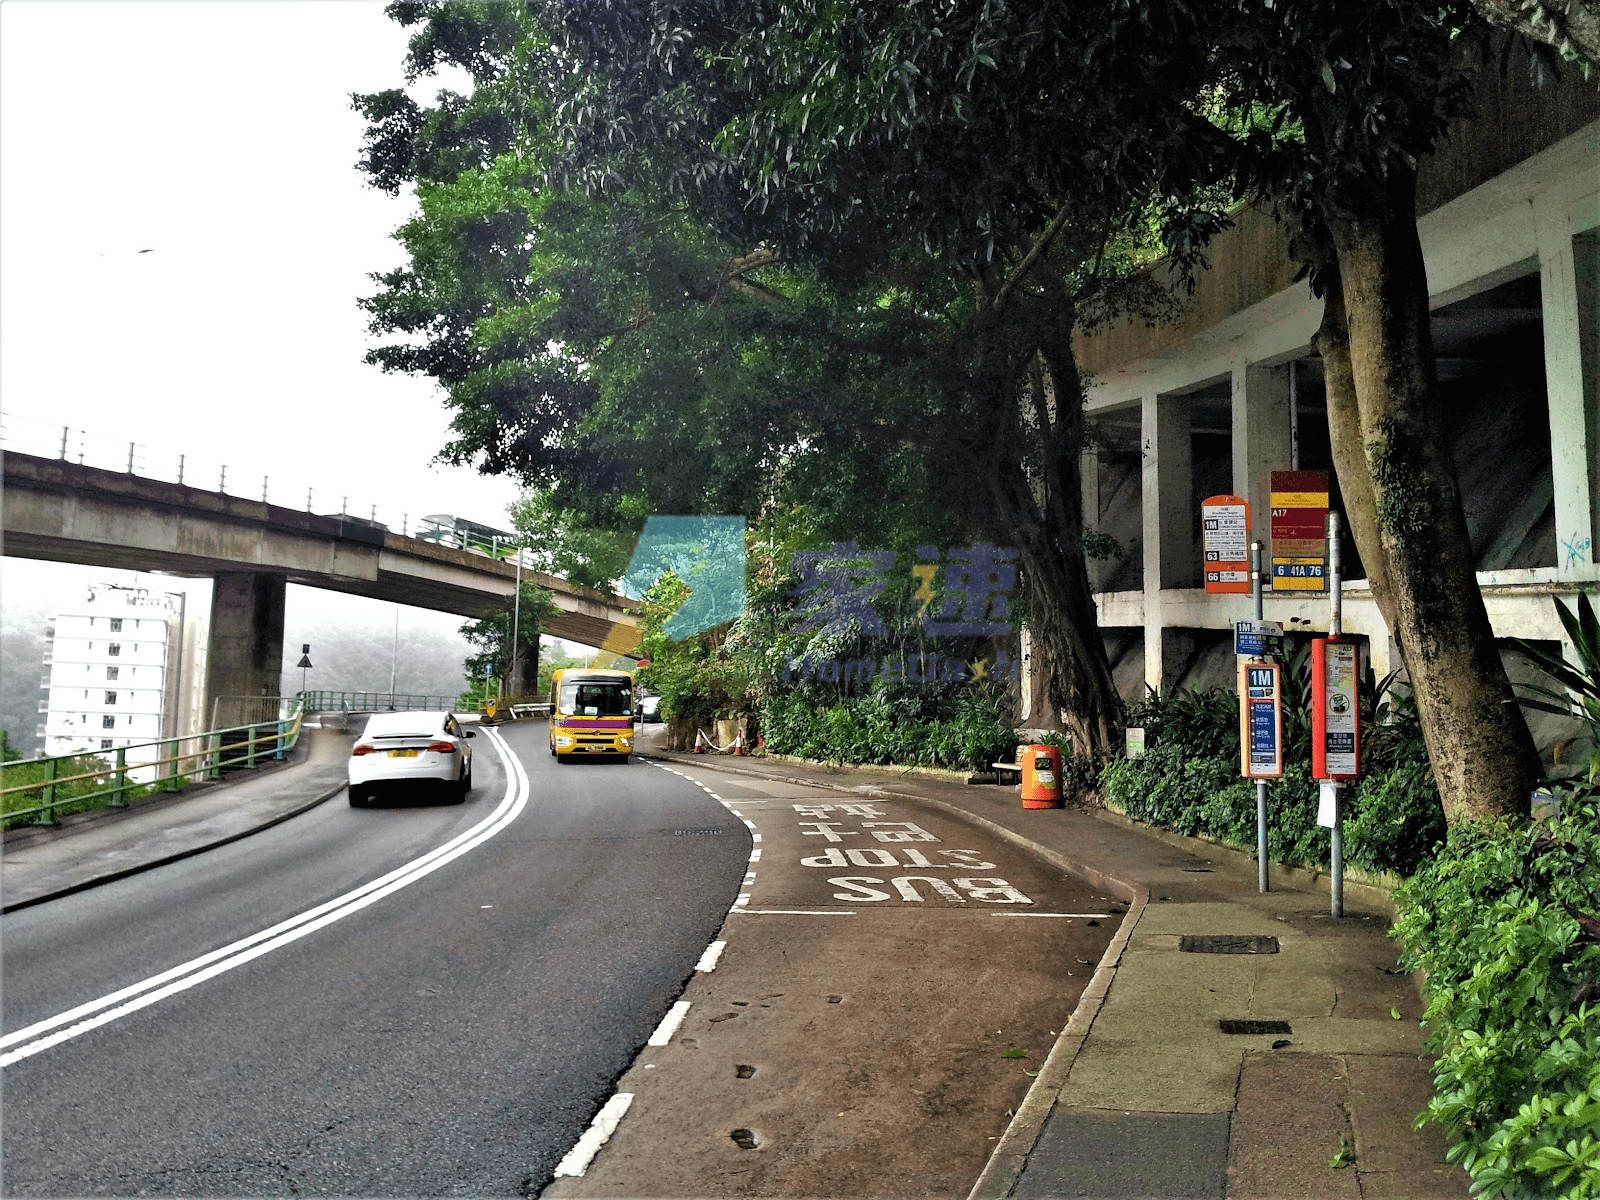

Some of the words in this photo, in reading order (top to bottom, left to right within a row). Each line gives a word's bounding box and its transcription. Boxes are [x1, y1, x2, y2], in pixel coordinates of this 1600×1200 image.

[1272, 509, 1287, 518] A17
[1205, 520, 1218, 530] 1M
[1207, 552, 1218, 561] 63
[1278, 566, 1285, 576] 6
[1291, 566, 1306, 576] 41A
[1309, 566, 1322, 576] 76
[1208, 572, 1219, 581] 66
[1237, 622, 1251, 632] 1M
[1251, 670, 1271, 686] 1M
[800, 848, 997, 870] STOP
[827, 876, 1035, 905] BUS
